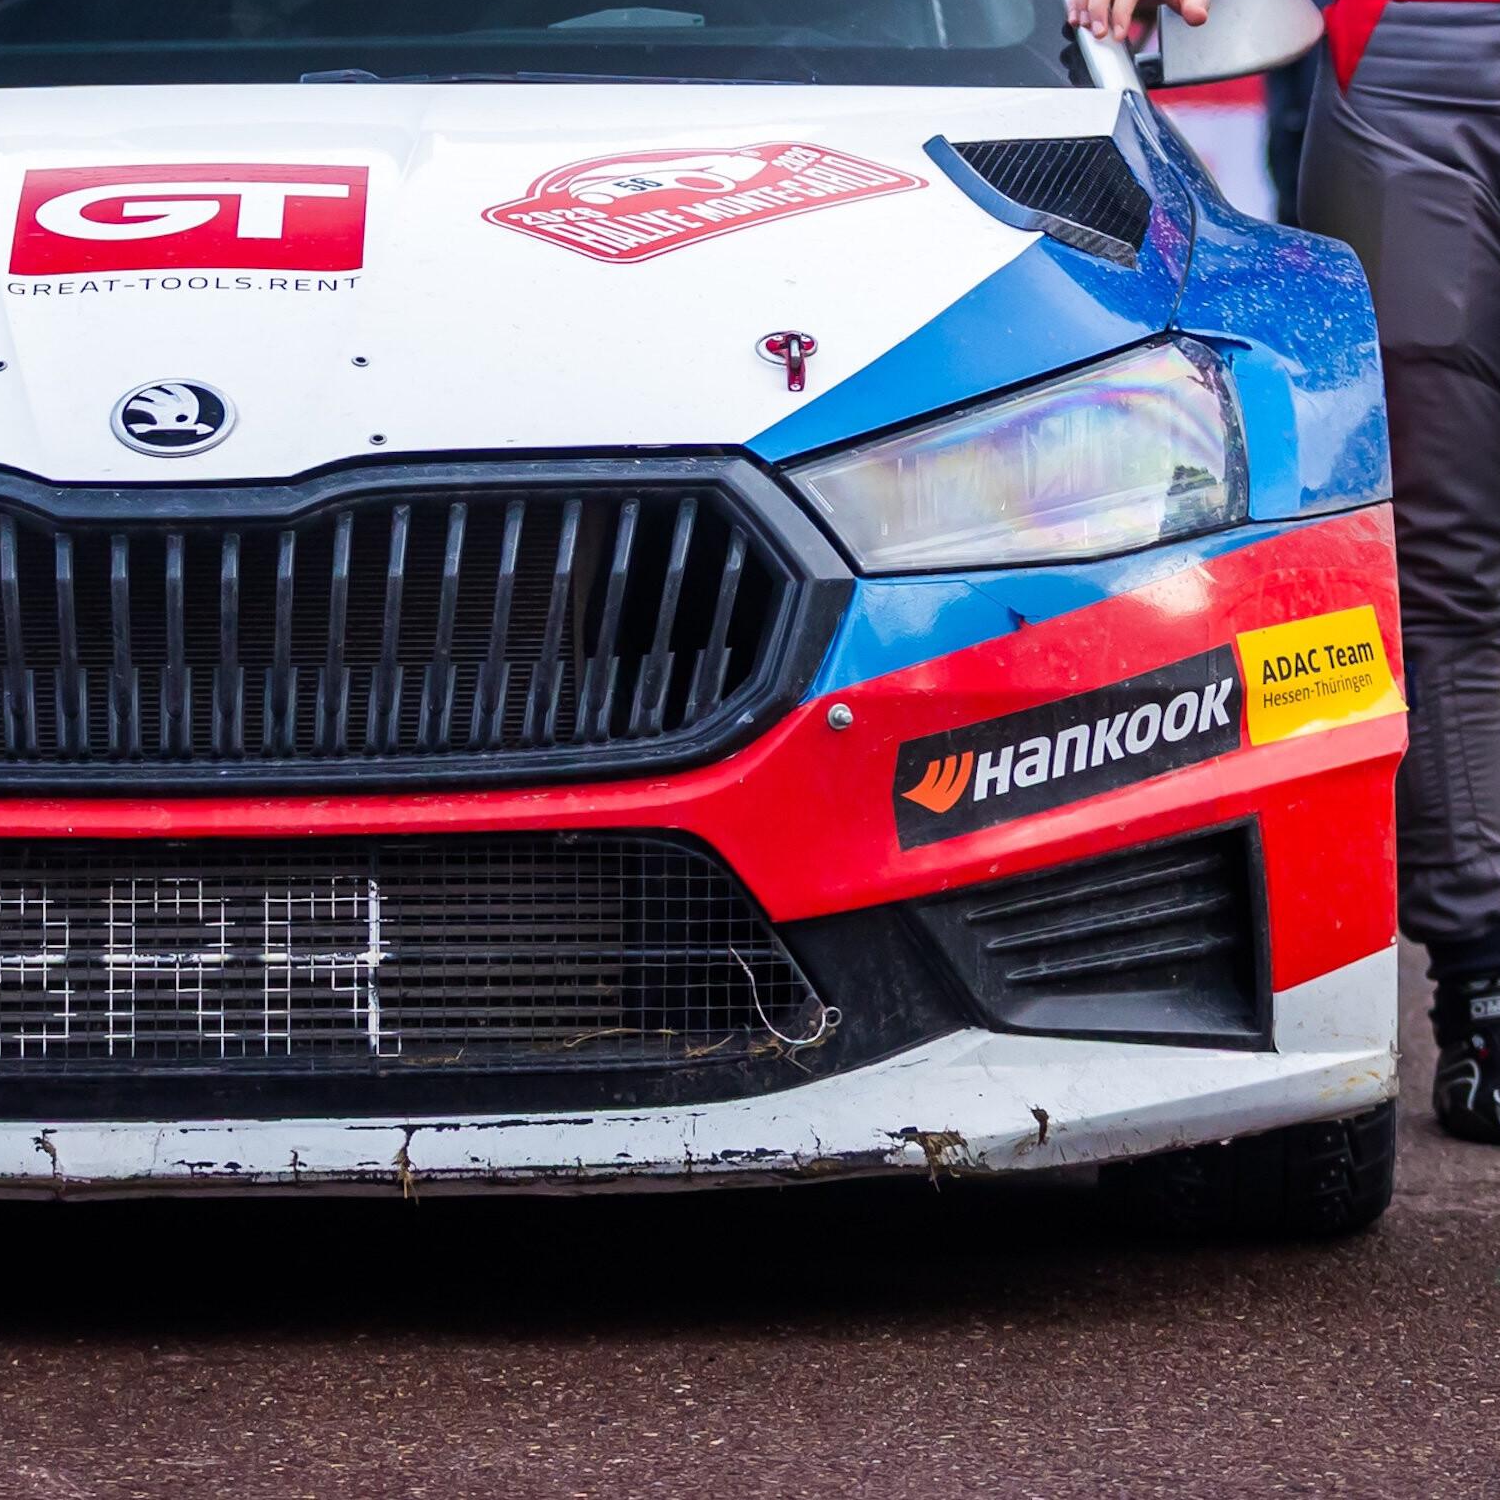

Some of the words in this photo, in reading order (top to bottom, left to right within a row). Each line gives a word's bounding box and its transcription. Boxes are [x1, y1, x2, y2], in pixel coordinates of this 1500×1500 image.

[612, 177, 663, 192] 56
[35, 181, 350, 242] GT
[536, 209, 704, 255] RALLYE
[677, 156, 901, 223] MONTE-CARLO
[7, 276, 362, 296] GREAT-TOOLS.RENT
[1262, 647, 1321, 685] ADAC
[1324, 640, 1375, 669] Team
[1262, 671, 1373, 709] Hessen-Thüringen
